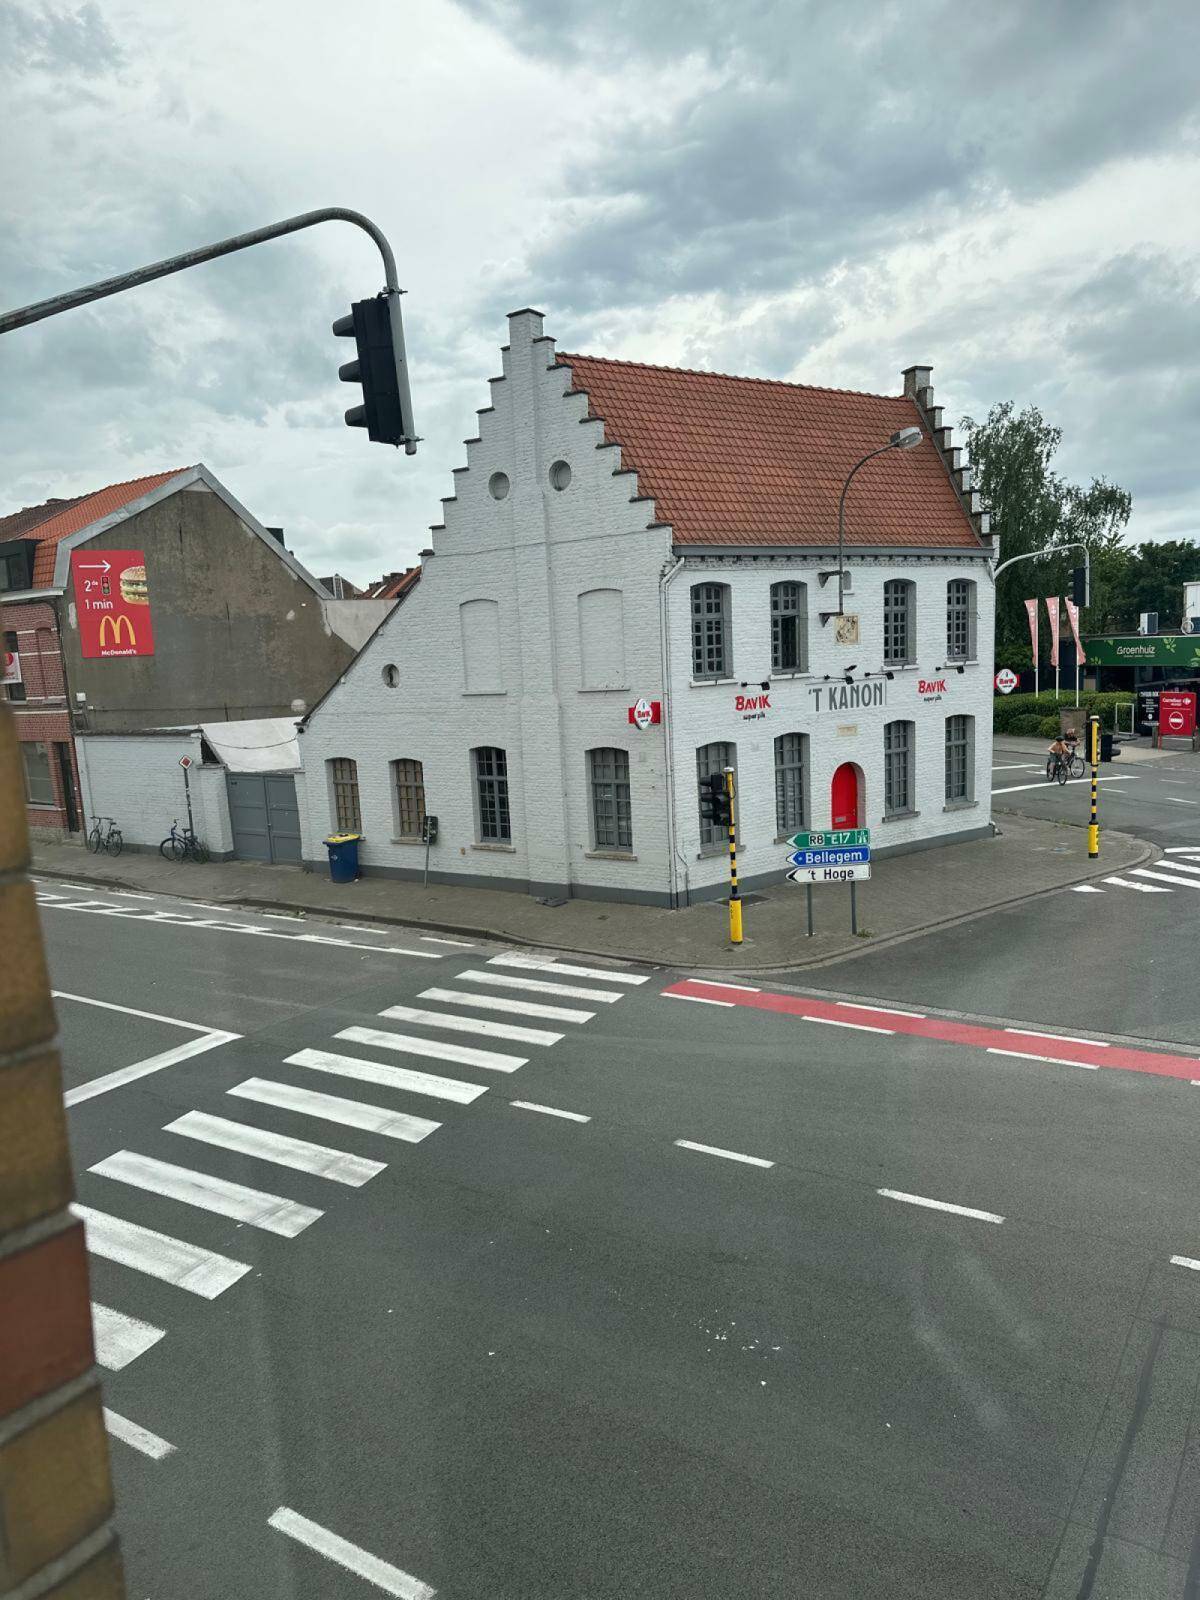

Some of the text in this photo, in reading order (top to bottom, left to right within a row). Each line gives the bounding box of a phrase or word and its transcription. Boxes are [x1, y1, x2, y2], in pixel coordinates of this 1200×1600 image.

[85, 599, 113, 610] 1 min
[101, 648, 137, 656] McDonald's
[1116, 645, 1155, 655] Groenhuiz
[918, 679, 947, 693] BAVIK
[735, 694, 771, 711] BAVIK
[829, 682, 882, 710] KANON
[809, 832, 850, 845] R8 E17
[805, 851, 862, 864] Bellegem
[808, 869, 854, 881] 't Hoge
